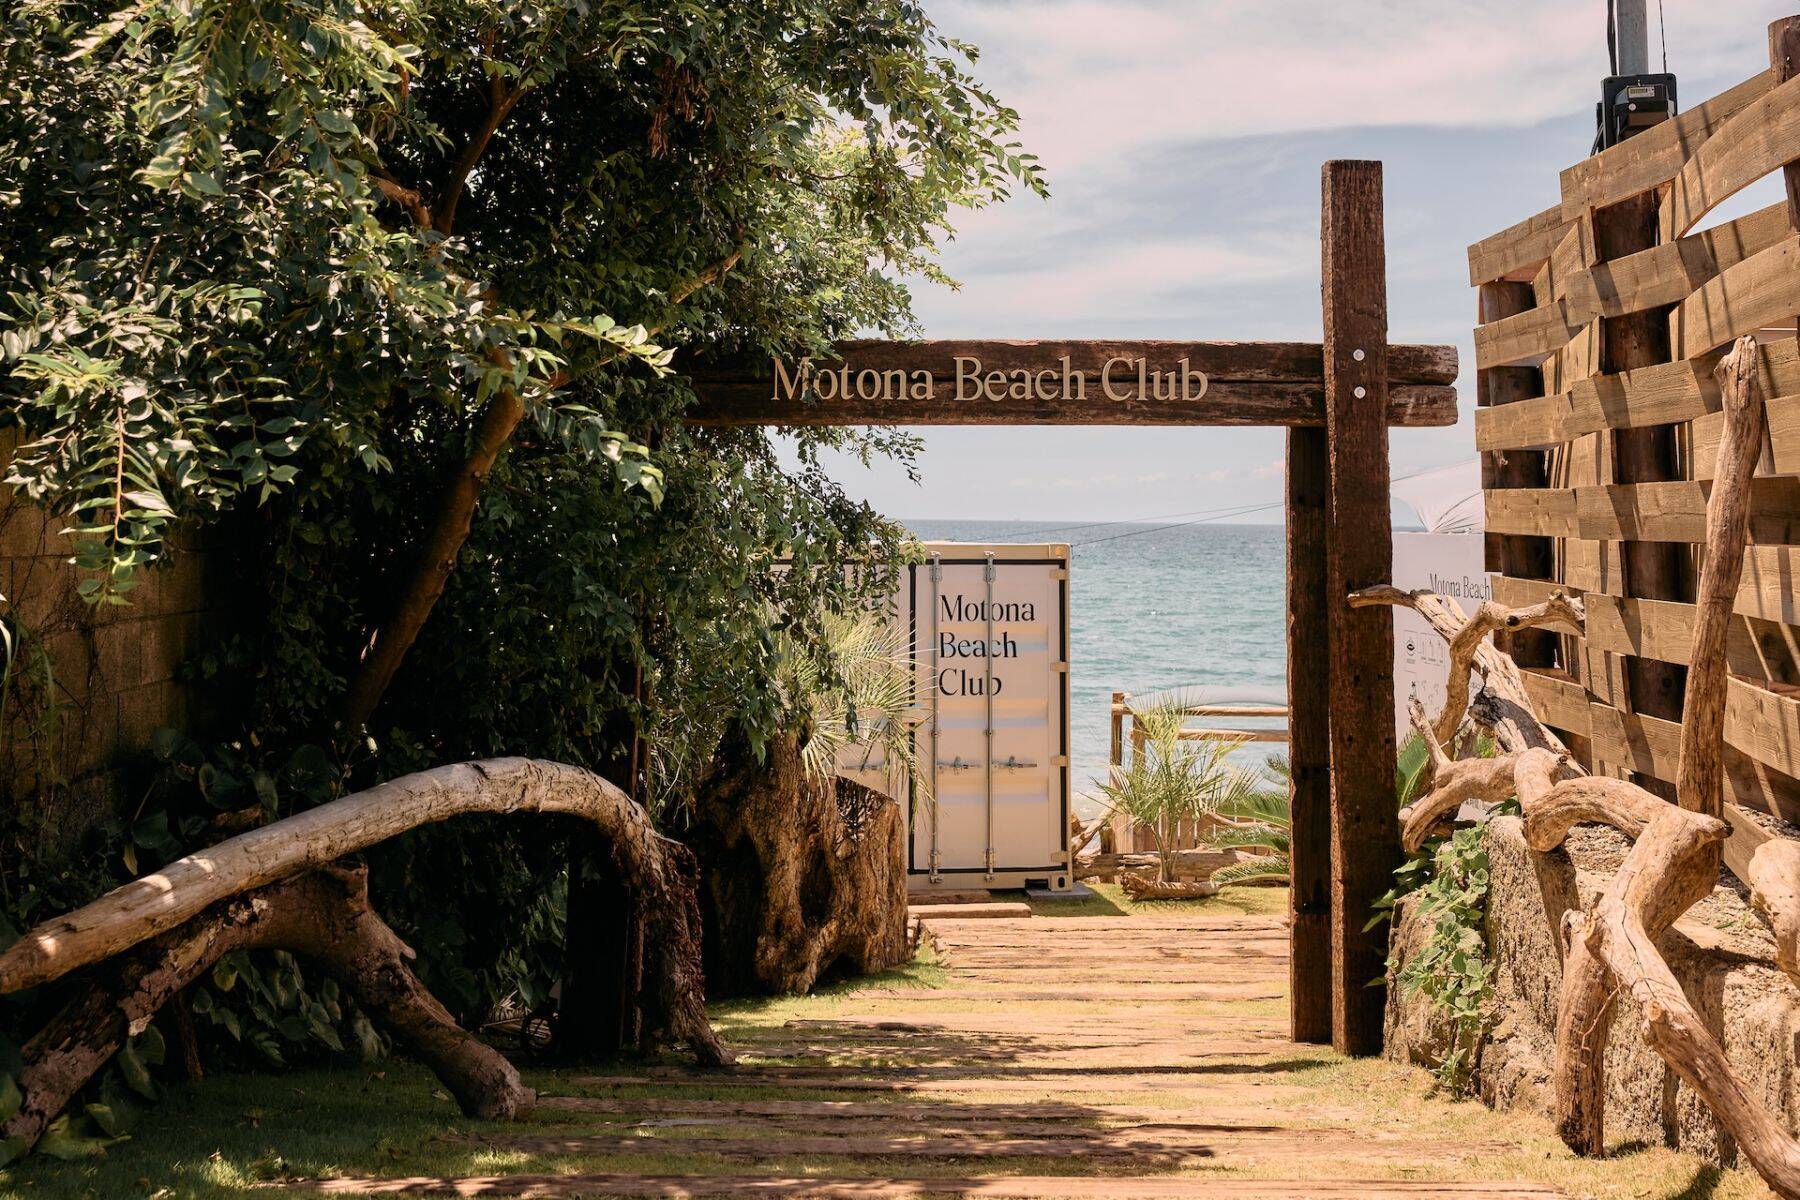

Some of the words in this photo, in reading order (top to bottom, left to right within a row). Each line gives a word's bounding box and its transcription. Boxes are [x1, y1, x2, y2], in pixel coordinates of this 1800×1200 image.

[771, 356, 936, 402] Motona
[953, 356, 1087, 402] Beach
[1101, 356, 1209, 402] Club
[1429, 573, 1461, 597] Motona
[1463, 576, 1490, 600] Beach
[940, 594, 1035, 621] Motona
[939, 631, 1017, 658] Beach
[938, 668, 1002, 696] Club
